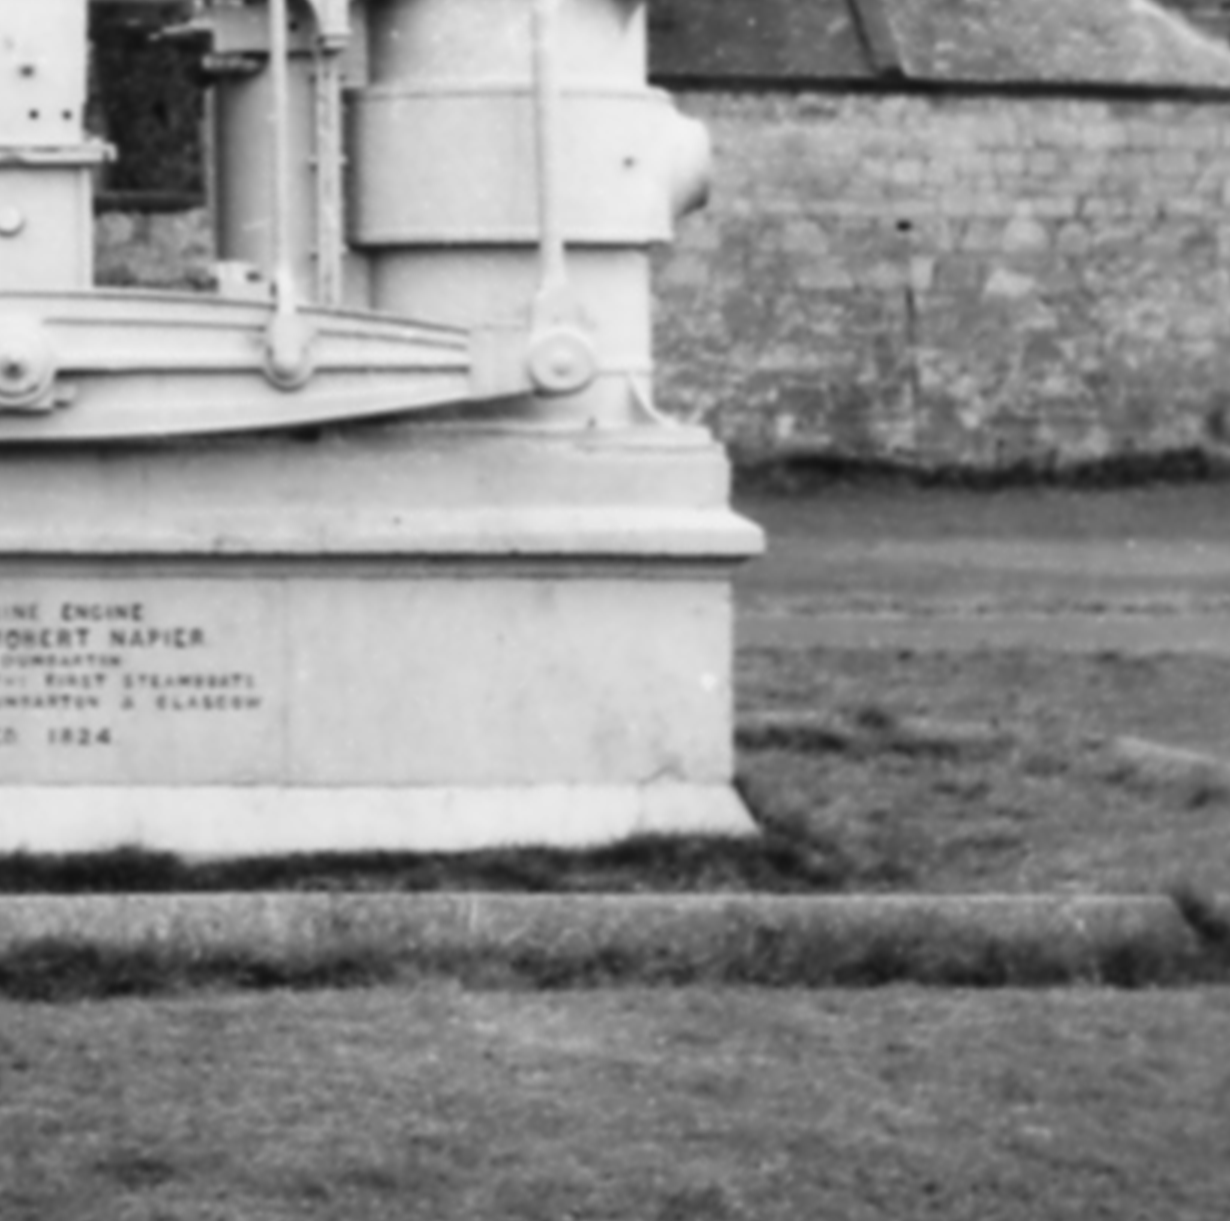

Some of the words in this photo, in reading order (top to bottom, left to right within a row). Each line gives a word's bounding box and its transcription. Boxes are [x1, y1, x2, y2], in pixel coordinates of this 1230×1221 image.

[59, 601, 145, 623] ENGINE
[108, 625, 206, 650] NAPIER
[46, 725, 113, 748] 1824
